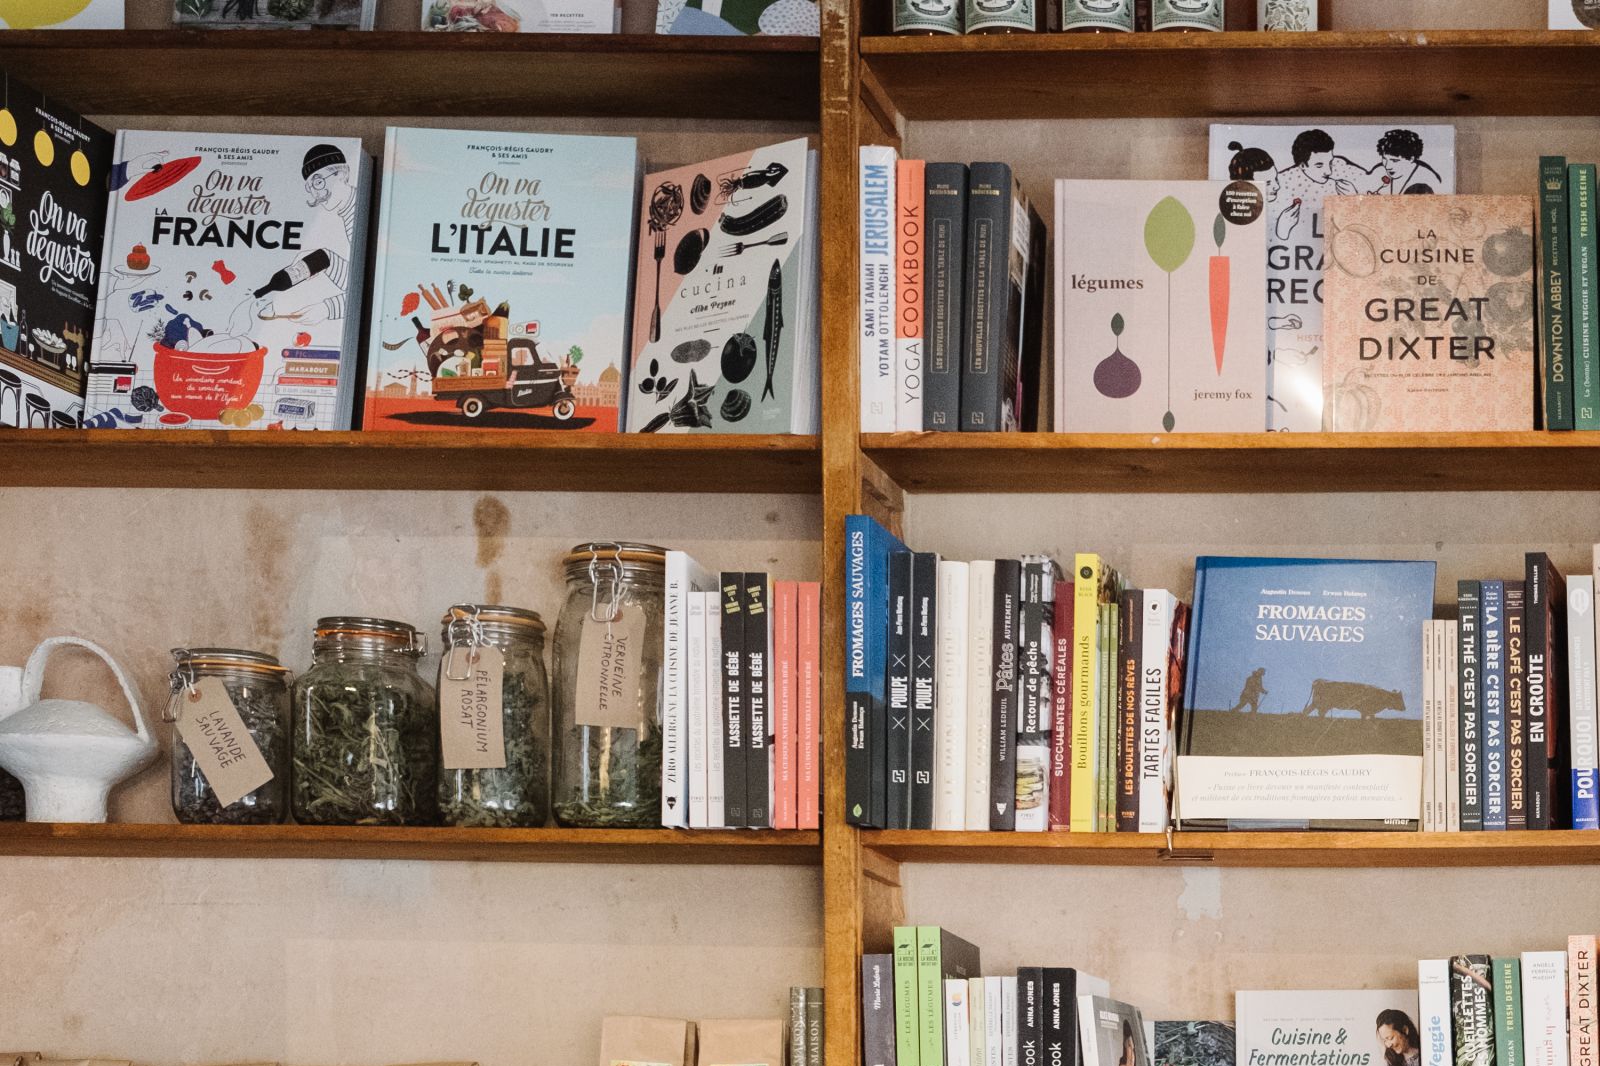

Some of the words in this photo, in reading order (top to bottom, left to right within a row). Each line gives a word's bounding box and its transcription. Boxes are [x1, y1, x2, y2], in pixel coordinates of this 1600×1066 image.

[252, 148, 279, 156] GAUDRY
[204, 168, 227, 192] On
[236, 174, 263, 192] va
[480, 171, 505, 196] On
[513, 178, 542, 196] va
[154, 207, 169, 217] LA
[865, 164, 888, 257] JERUSALEM
[152, 216, 303, 250] FRANCE
[431, 223, 576, 259] L'ITALIE
[1417, 229, 1437, 239] LA
[1380, 249, 1475, 263] CUISINE
[903, 205, 920, 338] COOKBOOK
[1071, 274, 1144, 292] légumes
[1417, 274, 1437, 286] DE
[680, 275, 747, 299] cucina
[1551, 270, 1563, 312] ABBEY
[1365, 297, 1489, 322] GREAT
[1359, 336, 1495, 360] DIXTER
[1551, 316, 1563, 382] DOWNTON
[905, 342, 920, 404] YOGA
[1194, 388, 1231, 402] jeremy
[1234, 388, 1252, 400] fox
[1257, 605, 1366, 622] FROMAGES
[1463, 614, 1474, 630] LE
[1255, 624, 1365, 642] SAUVAGES
[1463, 635, 1475, 664] THÉ
[1146, 668, 1162, 732] FACILES
[1464, 670, 1476, 709] C'EST
[1527, 654, 1544, 723] CROÛTE
[461, 689, 473, 729] ROSAT
[474, 669, 489, 753] PÉLARGONIUM
[208, 710, 247, 764] LAVANDE
[1464, 711, 1476, 741] PAS
[1530, 727, 1544, 743] EN
[195, 715, 231, 769] SAUVAGE
[1144, 735, 1160, 779] TARTES
[1465, 744, 1478, 806] SORCIER
[1271, 1027, 1332, 1045] Cuisine
[1336, 1027, 1348, 1044] &
[1248, 1048, 1370, 1066] Fermentations
